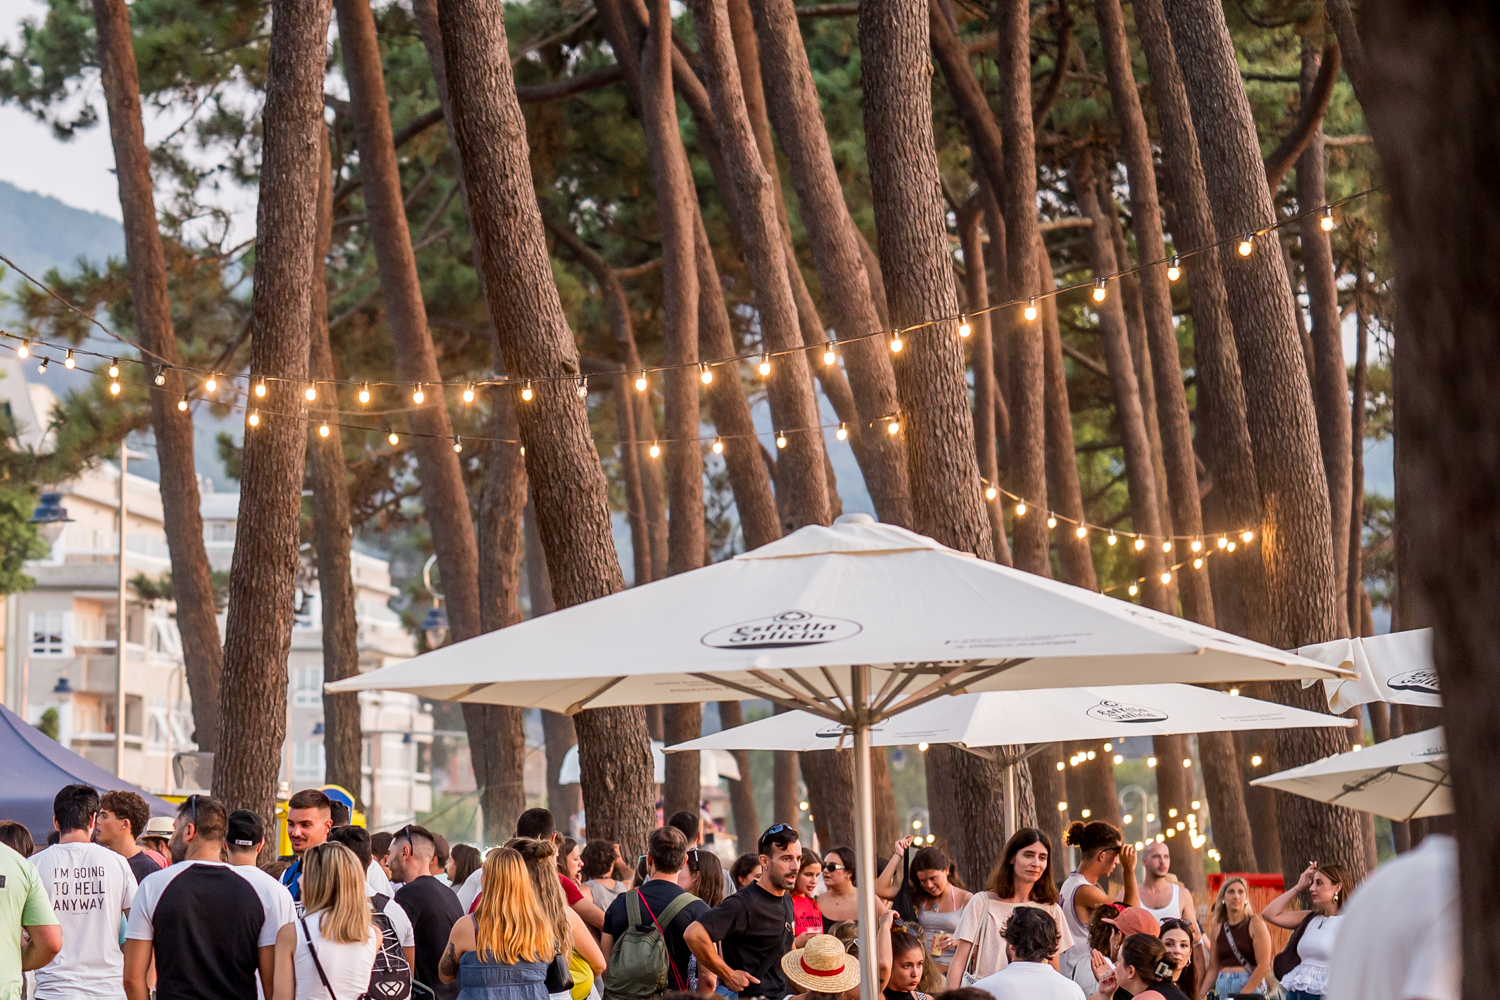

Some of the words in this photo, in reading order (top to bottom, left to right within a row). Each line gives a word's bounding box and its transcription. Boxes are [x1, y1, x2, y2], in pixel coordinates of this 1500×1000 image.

[733, 622, 838, 635] Estrella
[729, 630, 825, 643] Galicia
[54, 867, 69, 878] I'M
[73, 865, 105, 879] GOING
[53, 881, 69, 896] TO
[75, 880, 105, 896] HELL
[53, 897, 105, 912] ANYWAY
